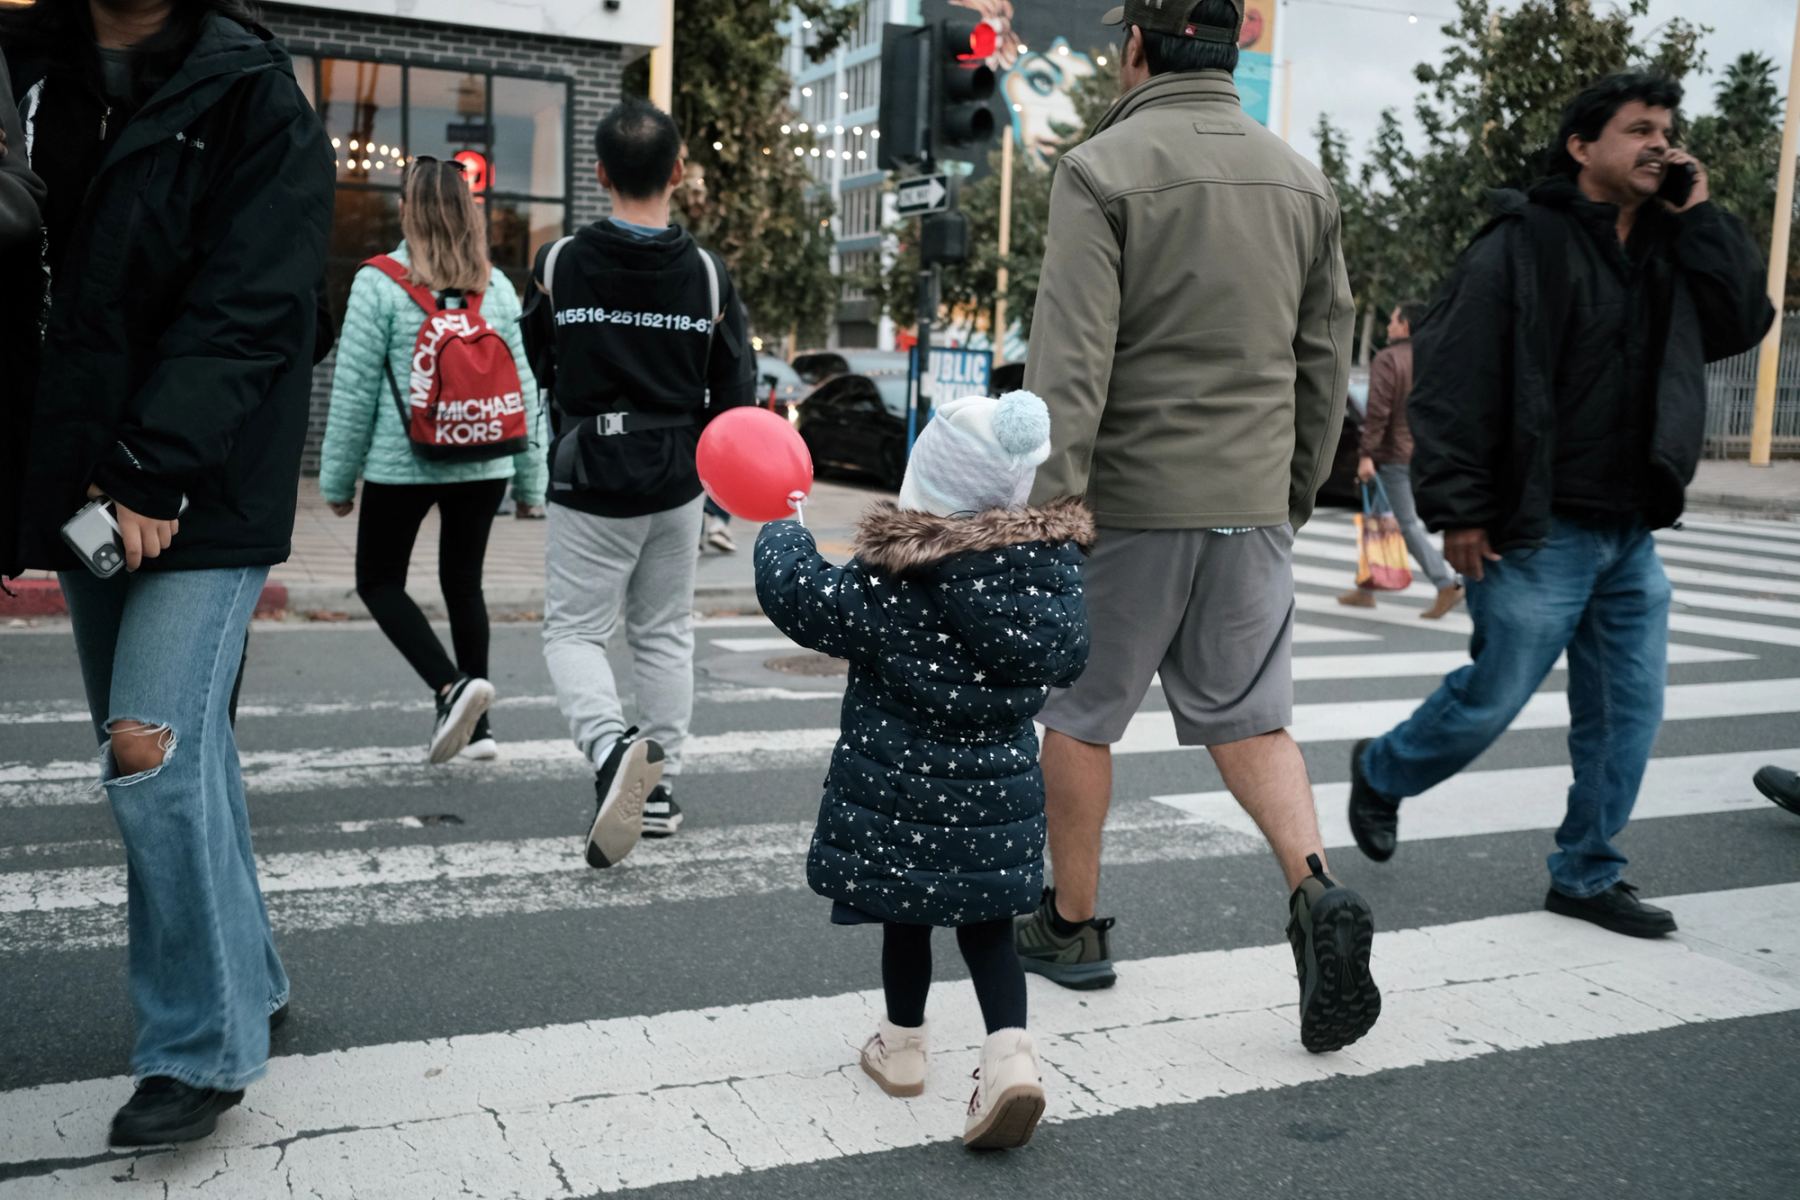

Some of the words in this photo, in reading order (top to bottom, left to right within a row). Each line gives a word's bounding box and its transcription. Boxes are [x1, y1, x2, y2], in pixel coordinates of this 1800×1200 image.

[409, 313, 480, 409] MICHAEL
[928, 351, 987, 384] UBLIC
[436, 391, 524, 421] MICHAEL
[435, 420, 503, 444] KORS
